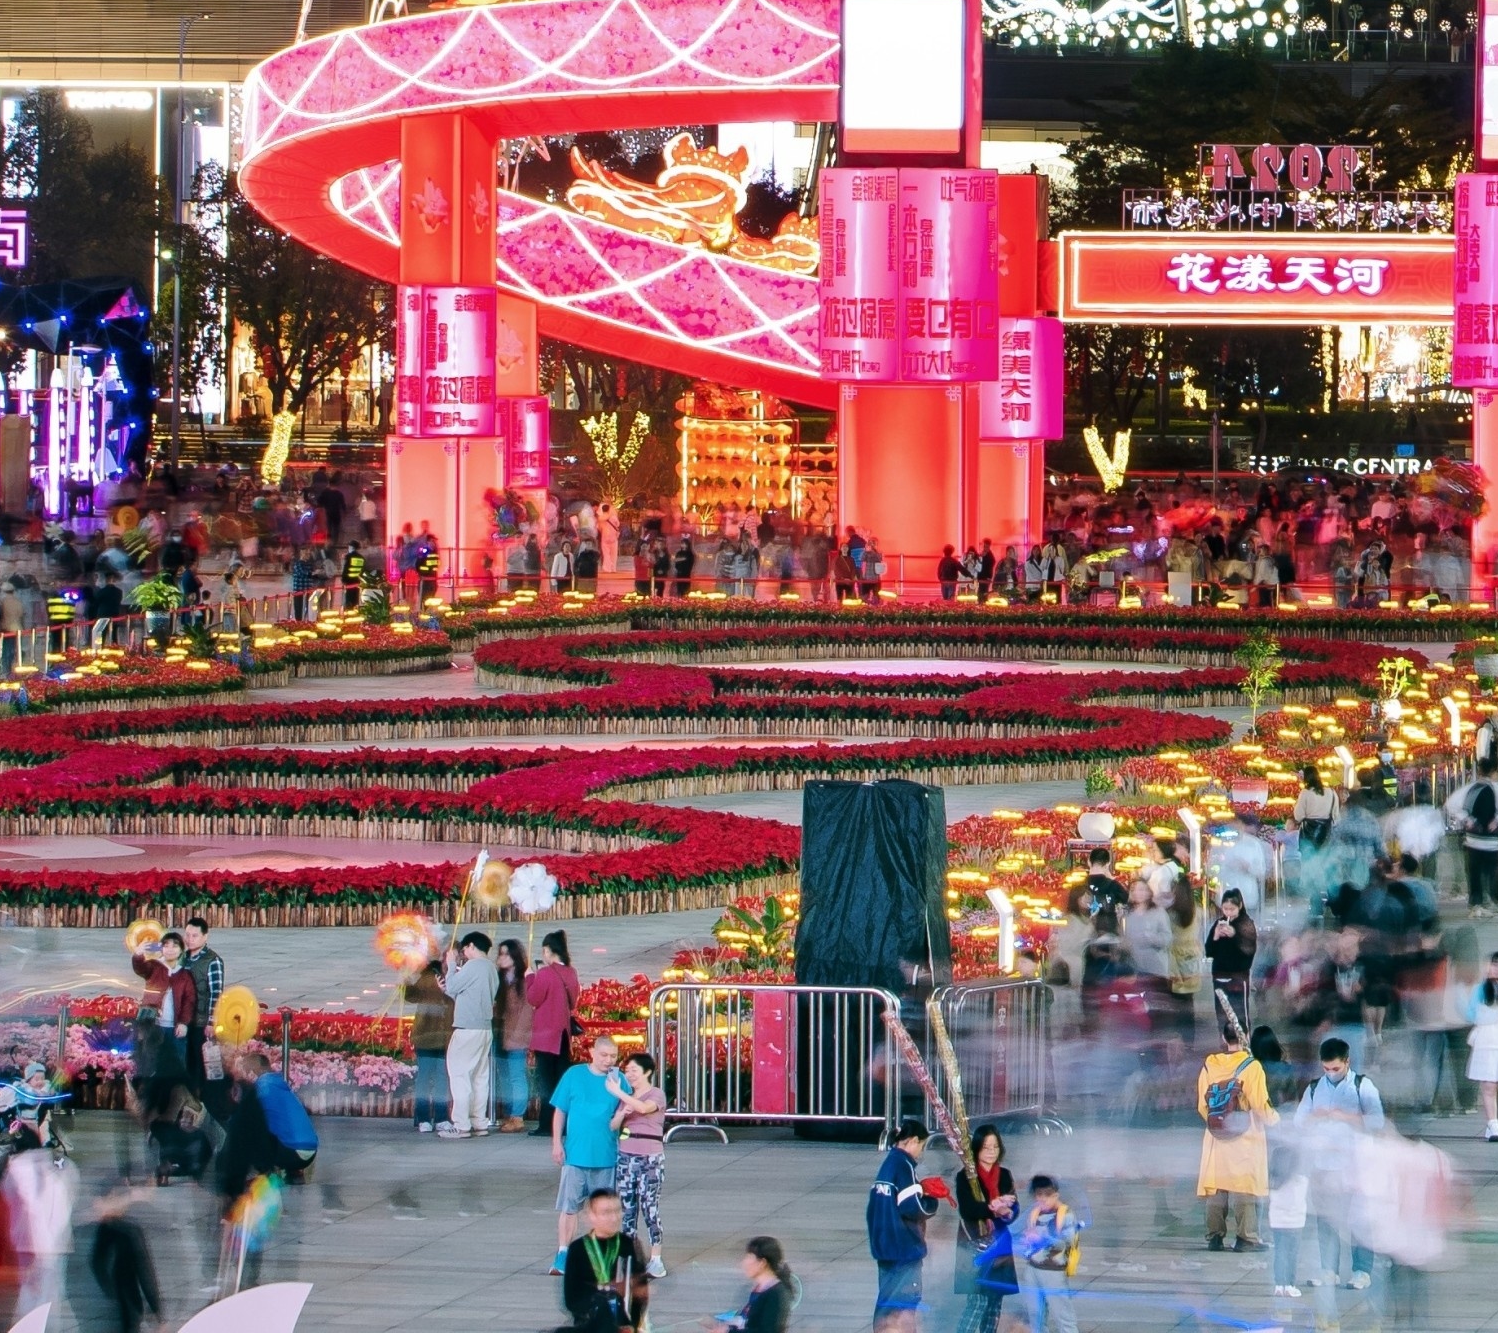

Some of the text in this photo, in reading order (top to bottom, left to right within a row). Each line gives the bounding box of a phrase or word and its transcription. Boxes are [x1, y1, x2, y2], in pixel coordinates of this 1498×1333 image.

[1166, 252, 1390, 296] 花漾天河
[1001, 331, 1031, 422] 绿美天河
[1353, 457, 1433, 475] CENTRA
